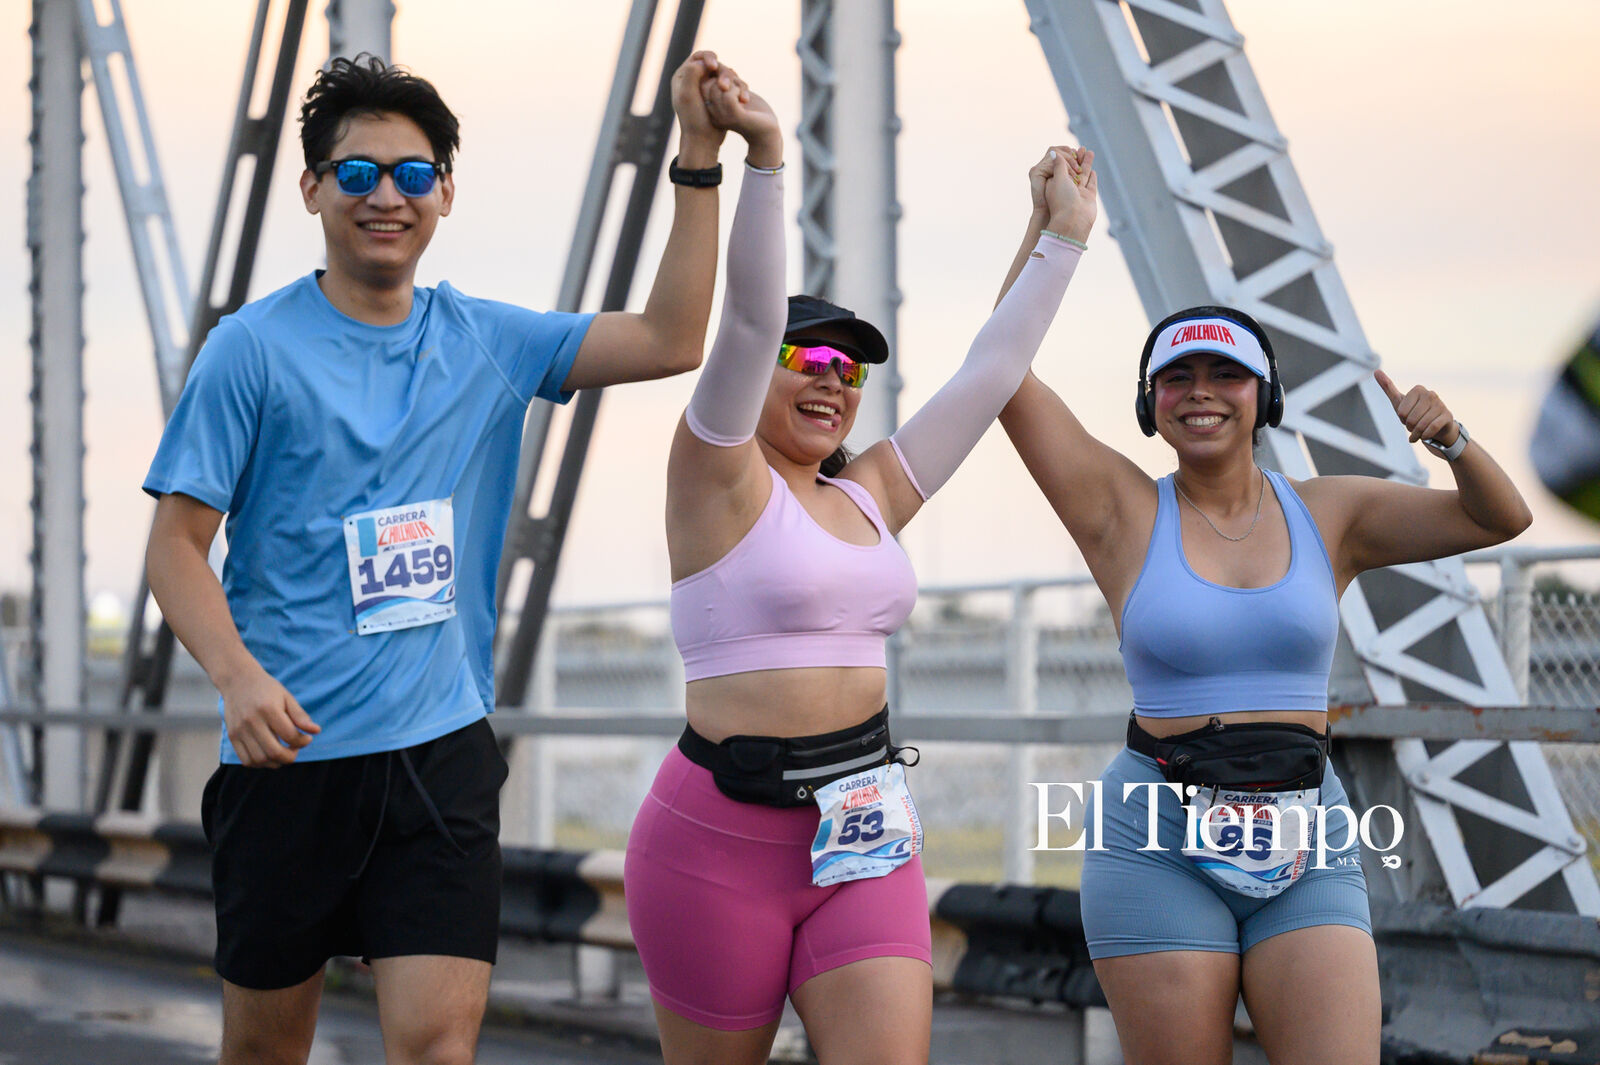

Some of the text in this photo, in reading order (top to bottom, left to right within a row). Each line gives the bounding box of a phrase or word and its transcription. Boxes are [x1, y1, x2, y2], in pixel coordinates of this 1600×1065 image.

[1171, 324, 1236, 347] CHILCHOTA
[378, 510, 427, 527] CARRERA
[377, 520, 435, 547] CHILCHOTA
[358, 544, 453, 596] 1459
[839, 775, 878, 793] CARRERA
[1224, 794, 1279, 805] CARRERA
[838, 810, 885, 846] 53
